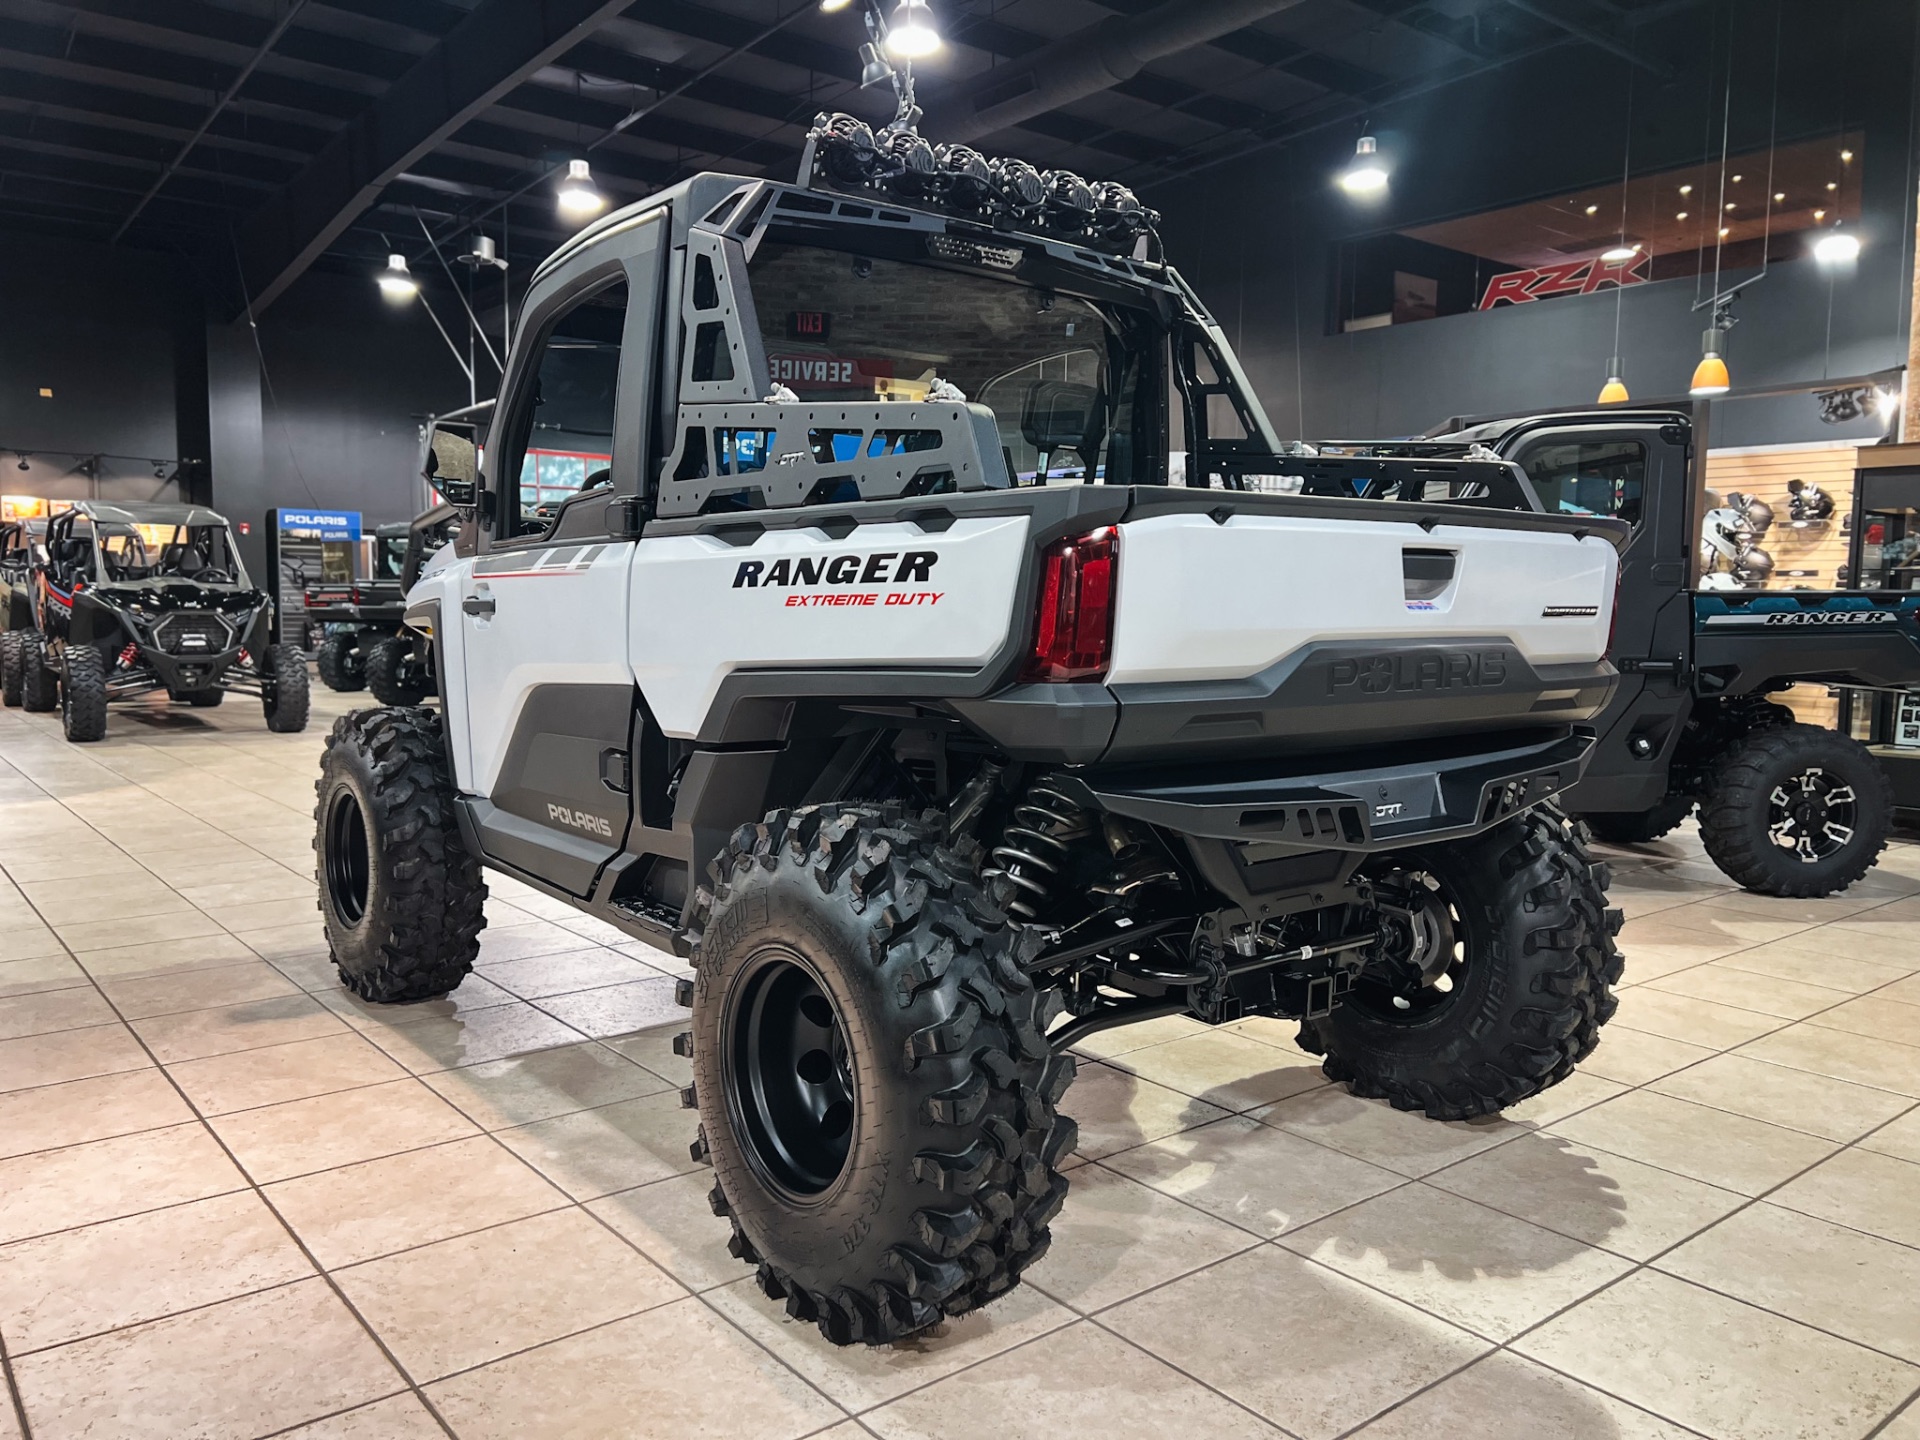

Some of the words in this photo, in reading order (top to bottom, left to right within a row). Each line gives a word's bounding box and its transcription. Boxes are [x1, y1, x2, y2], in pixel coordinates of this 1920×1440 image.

[1478, 248, 1651, 311] RZR
[284, 514, 348, 526] POLARIS
[732, 551, 938, 588] RANGER
[785, 593, 879, 607] EXTREME
[884, 592, 945, 606] DUTY
[1764, 611, 1887, 625] RANGER
[1326, 652, 1507, 697] POLARIS
[547, 803, 612, 837] POLARIS
